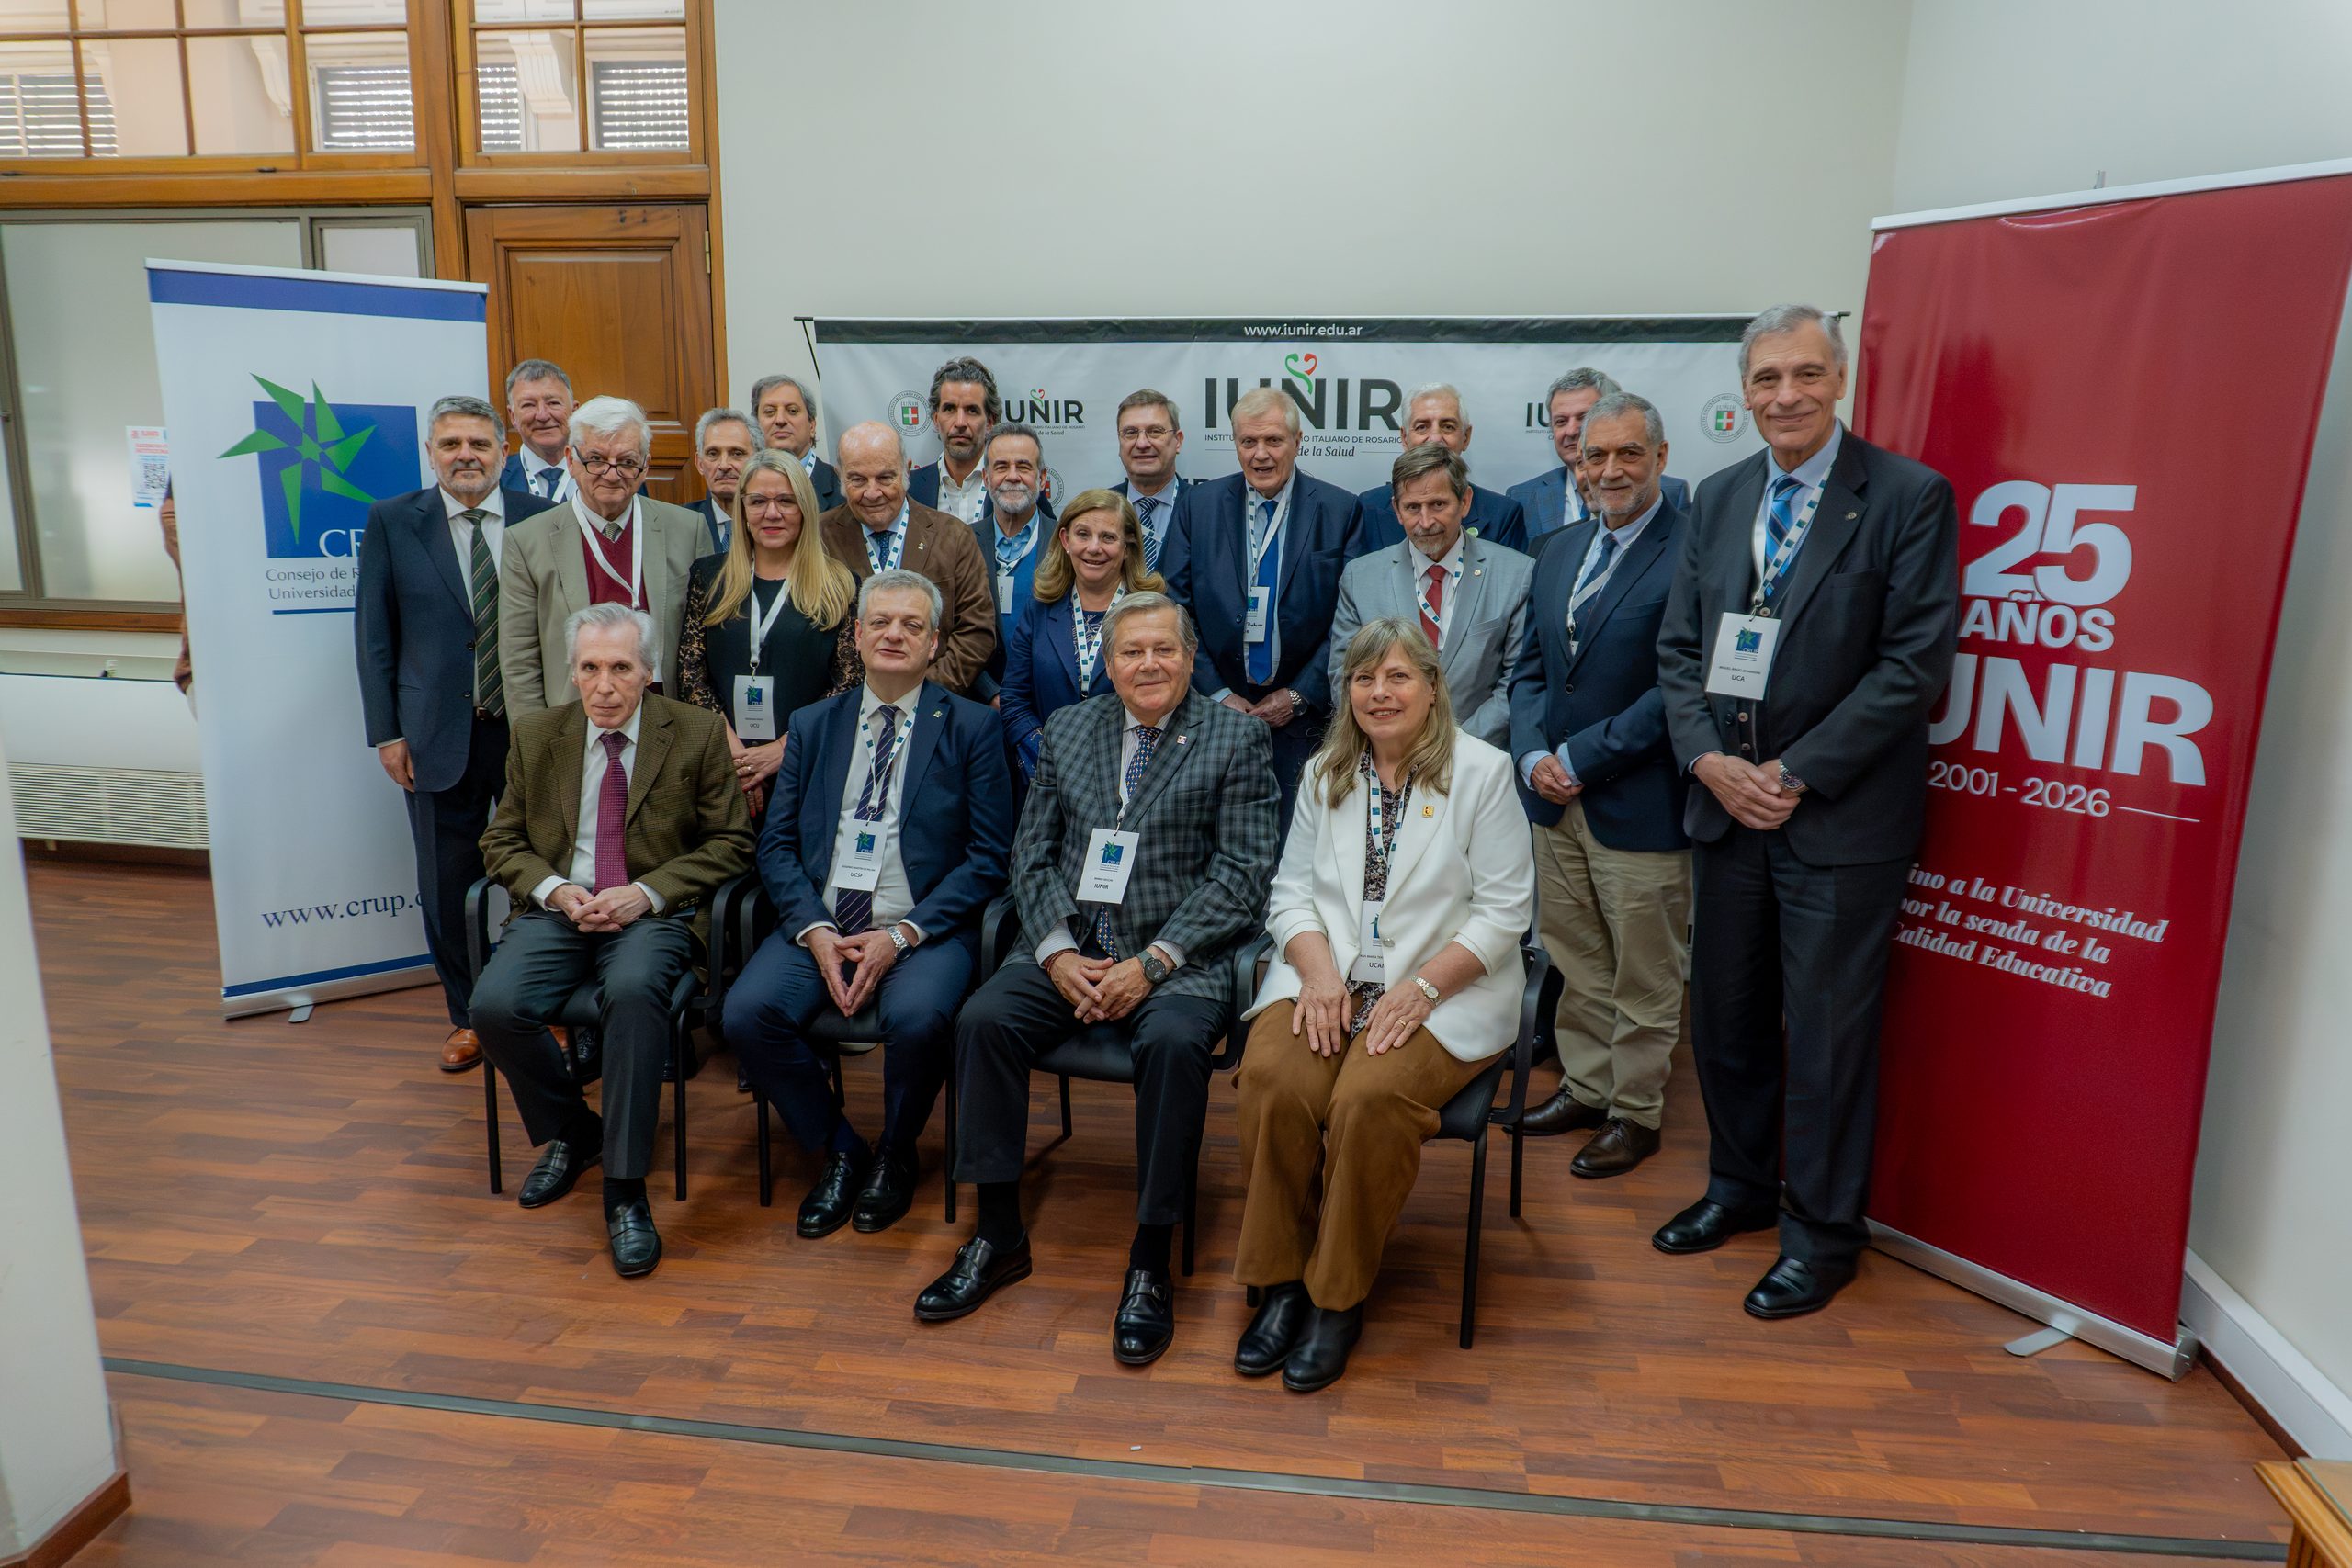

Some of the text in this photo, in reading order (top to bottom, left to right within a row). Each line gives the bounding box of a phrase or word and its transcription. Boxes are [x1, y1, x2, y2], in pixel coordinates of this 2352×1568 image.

[1244, 323, 1363, 336] www.iunir.edu.ar
[1312, 435, 1351, 444] ITALIANO
[1312, 446, 1323, 457] la
[1325, 446, 1356, 457] Salud
[1962, 479, 2137, 607] 25
[266, 568, 324, 583] Consejo
[330, 567, 347, 580] de
[269, 585, 356, 600] Universidad
[1959, 591, 2116, 652] AÑOS
[1947, 879, 1967, 896] a
[1969, 877, 1997, 902] la
[2000, 885, 2170, 943] Universidad
[1935, 901, 1962, 926] la
[1962, 914, 2041, 947] senda
[2041, 930, 2079, 955] de
[2079, 937, 2111, 964] la
[1894, 921, 2112, 998] alidad Educativa
